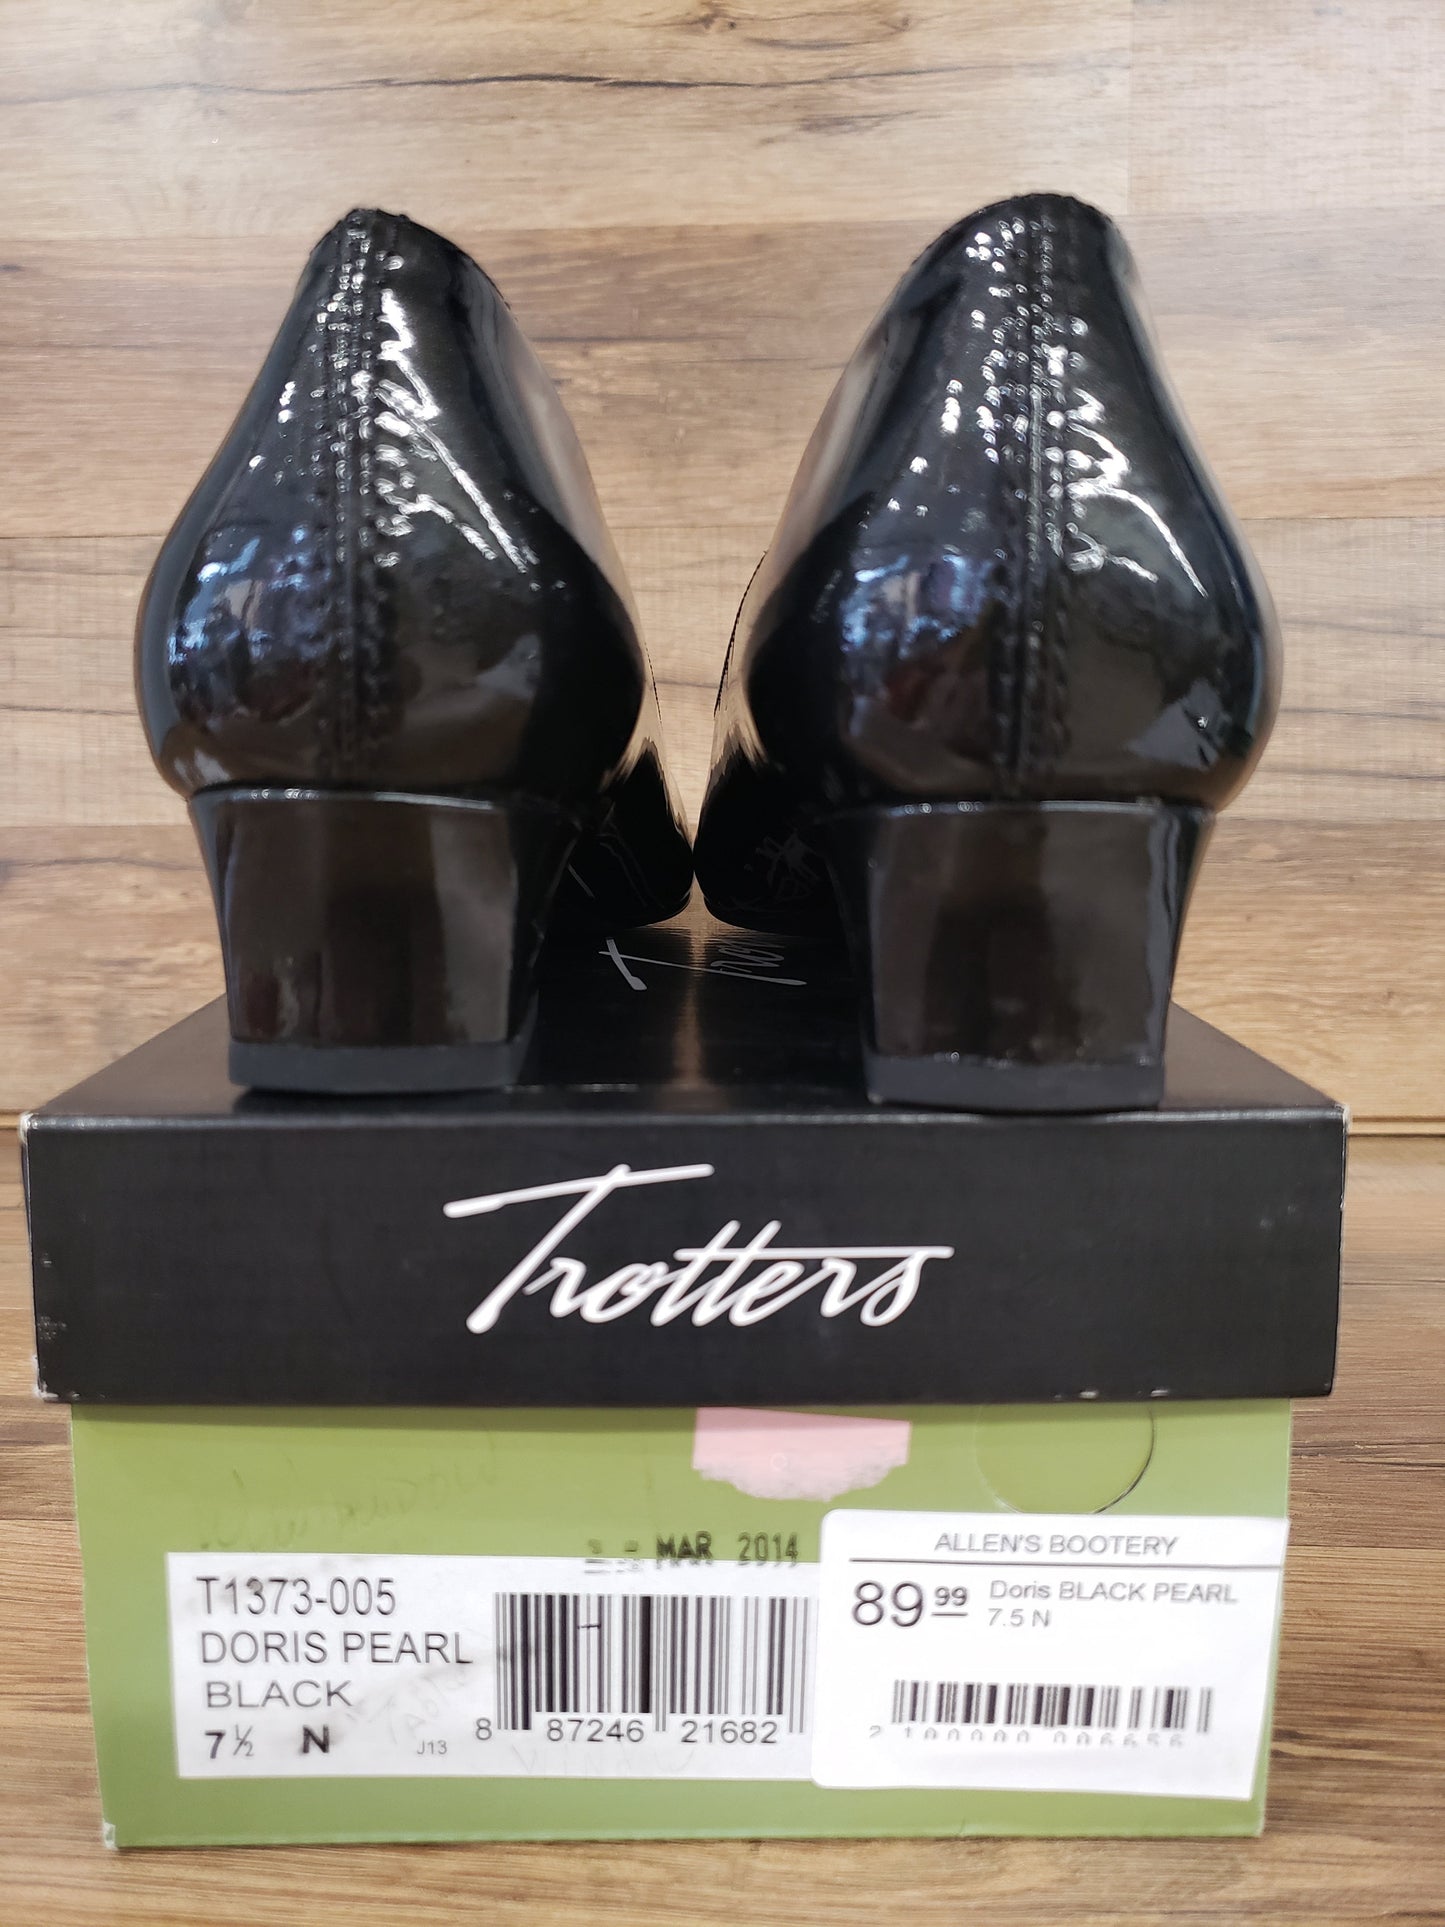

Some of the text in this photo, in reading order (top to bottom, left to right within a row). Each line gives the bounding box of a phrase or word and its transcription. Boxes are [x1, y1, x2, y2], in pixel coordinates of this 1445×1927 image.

[443, 1164, 954, 1334] Trotters
[656, 1531, 713, 1564] MAR
[737, 1531, 799, 1565] 2014
[934, 1533, 1179, 1556] ALLEN'S BOOTERY
[196, 1577, 397, 1616] T1373-005
[989, 1580, 1239, 1604] Doris BLACK PEARL
[987, 1608, 1051, 1628] 7.5 N
[201, 1631, 474, 1665] DORIS PEARL
[205, 1679, 354, 1709] BLACK
[301, 1723, 331, 1755] N
[475, 1717, 779, 1745] 8 87246 21682
[416, 1739, 448, 1756] J13
